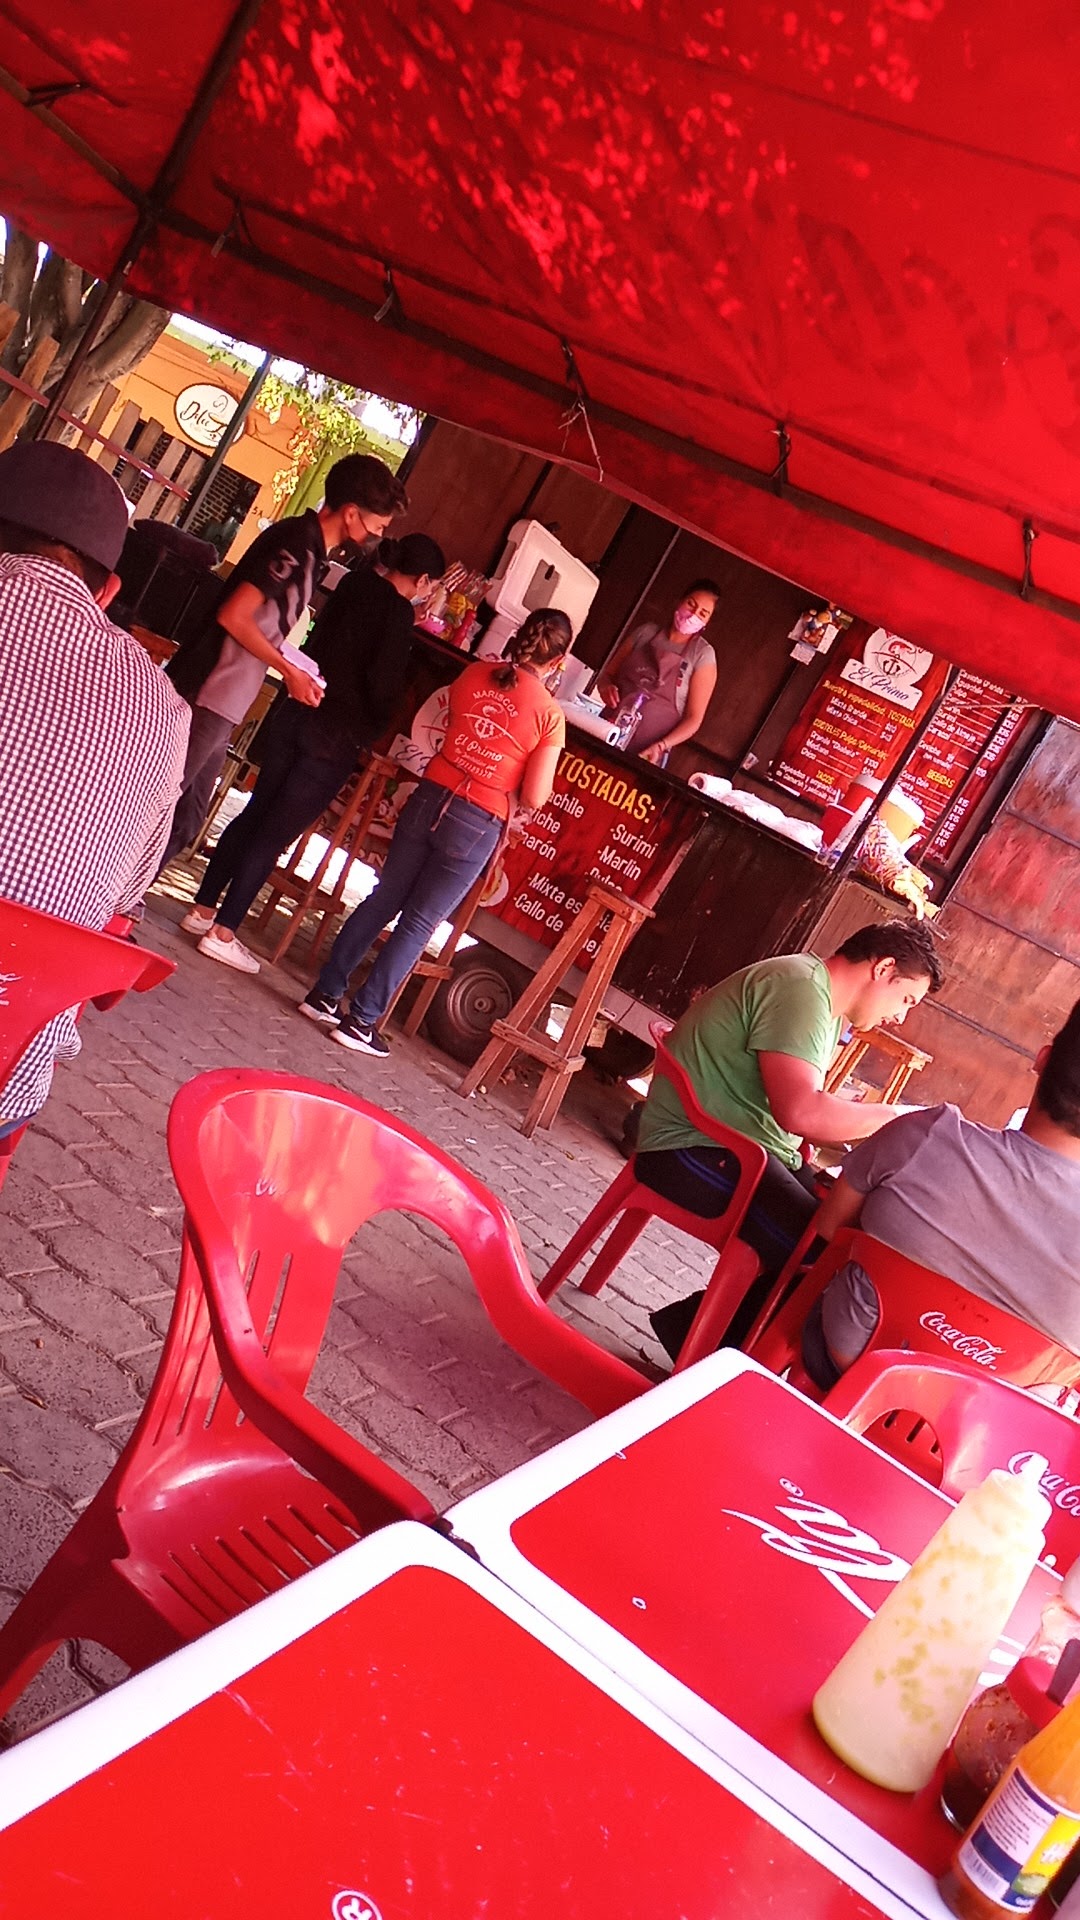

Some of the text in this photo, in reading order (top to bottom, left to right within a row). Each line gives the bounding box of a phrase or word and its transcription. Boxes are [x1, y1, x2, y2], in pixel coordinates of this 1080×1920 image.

[848, 666, 909, 701] El Primo
[473, 689, 519, 719] MARISCOS
[454, 734, 468, 747] El
[469, 741, 504, 762] Primo
[557, 752, 655, 822] TOSTADAS:
[546, 911, 564, 932] de
[919, 1311, 1006, 1368] Coca-Cola
